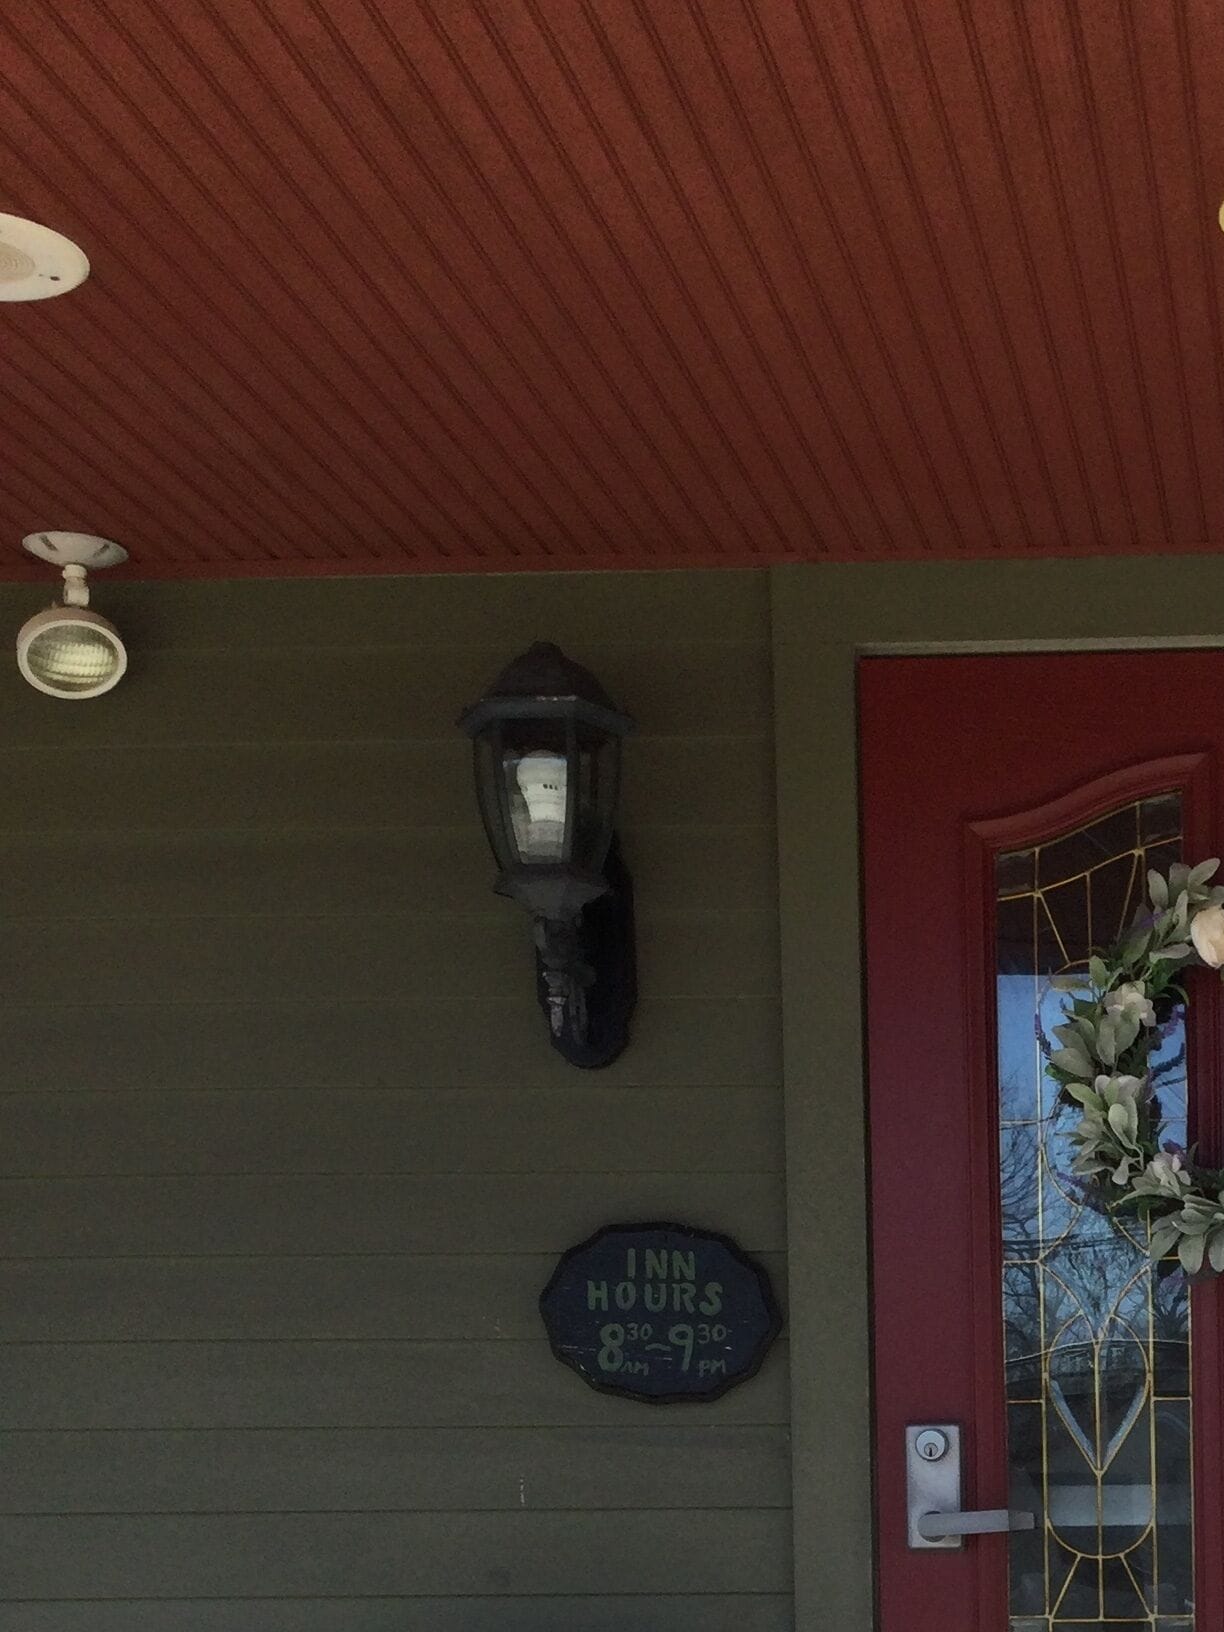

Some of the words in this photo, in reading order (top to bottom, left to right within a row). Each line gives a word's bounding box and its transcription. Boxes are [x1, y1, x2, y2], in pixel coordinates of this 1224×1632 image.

[627, 1248, 696, 1280] INN
[587, 1280, 723, 1316] HOURS
[699, 1359, 727, 1377] PM
